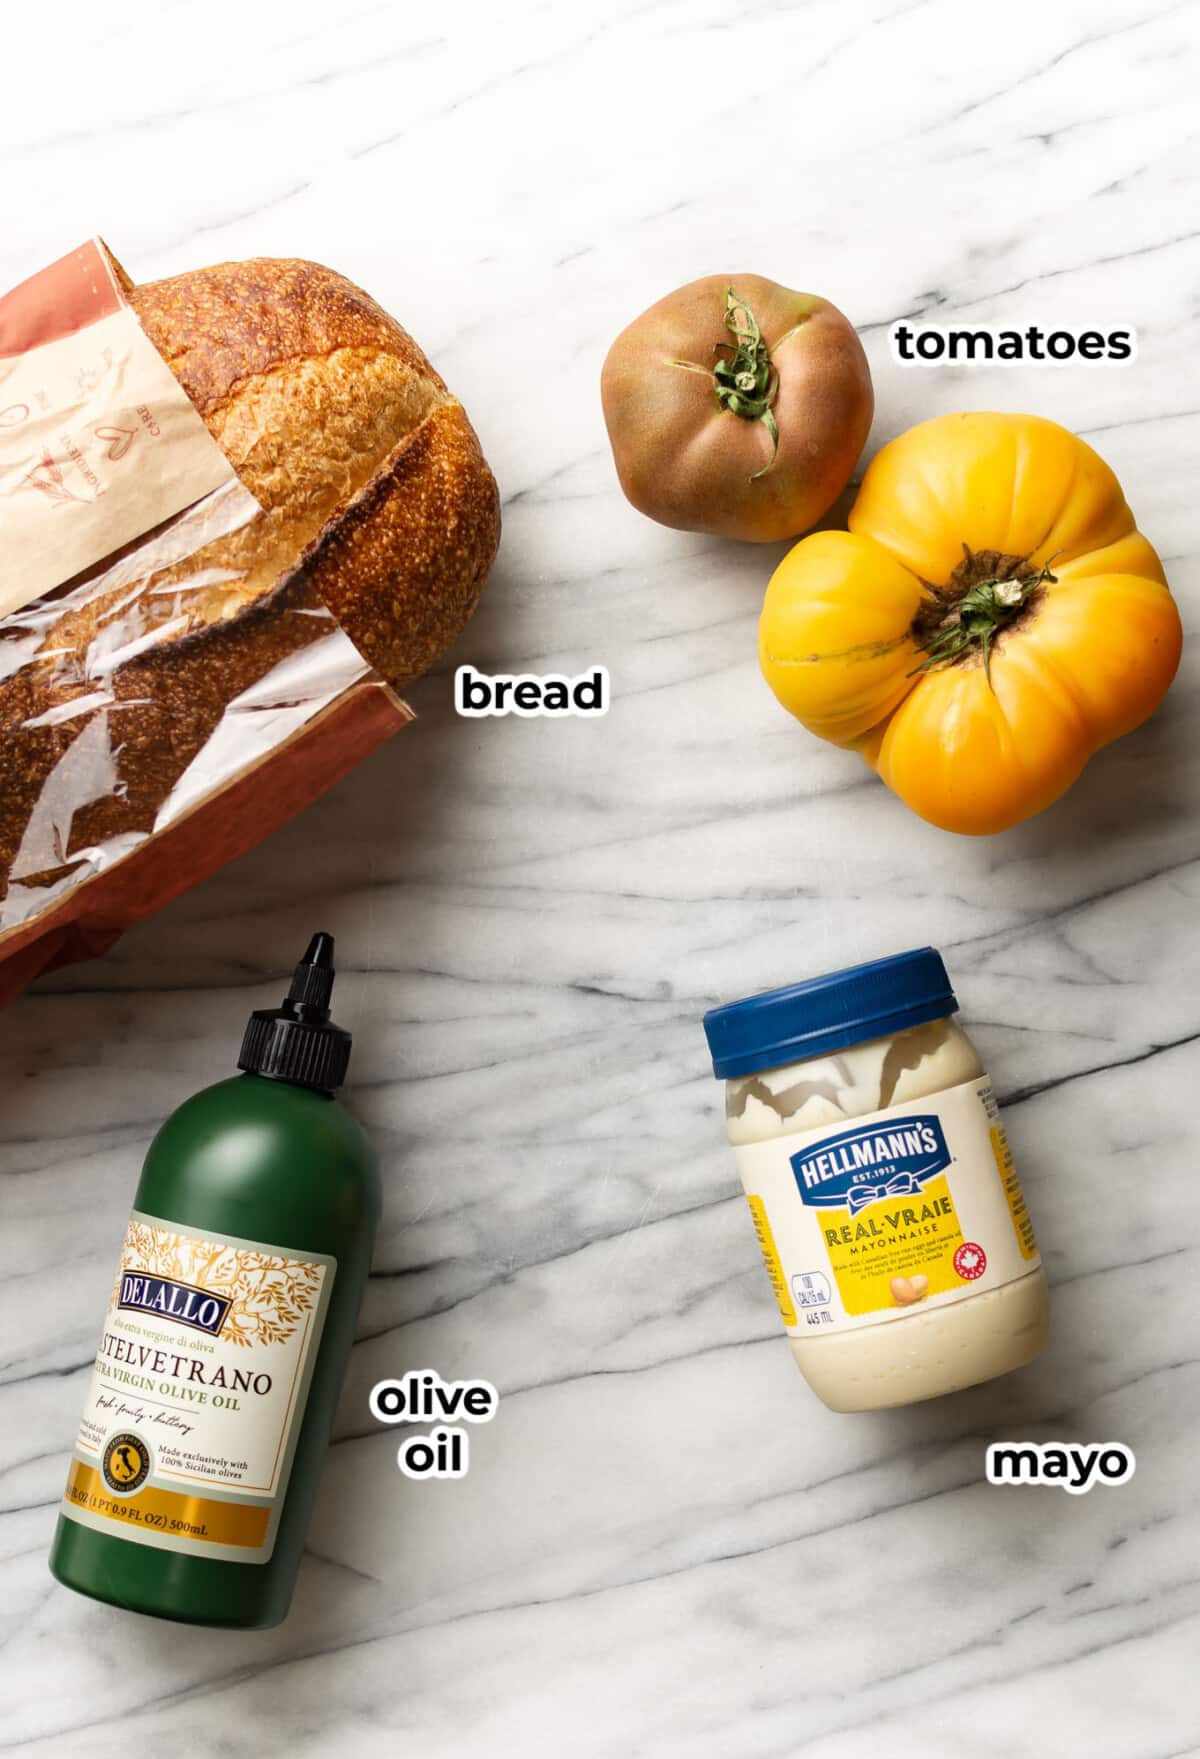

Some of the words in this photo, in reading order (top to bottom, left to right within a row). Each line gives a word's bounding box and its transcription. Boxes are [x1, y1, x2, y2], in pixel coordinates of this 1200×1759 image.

[137, 405, 160, 437] CARE
[801, 1122, 938, 1189] HELLMANN'S
[850, 1223, 939, 1256] MAYONNAISE
[122, 1277, 220, 1327] DELALLO
[142, 1328, 175, 1345] vergine
[177, 1335, 187, 1348] di
[189, 1341, 215, 1354] oliva
[101, 1333, 272, 1395] STELVETRANO
[112, 1367, 154, 1391] VIRGIN
[159, 1382, 207, 1404] OLIVE
[212, 1394, 241, 1411] OIL
[153, 1412, 196, 1436] buttery
[158, 1444, 181, 1458] Made
[182, 1450, 228, 1468] exclusively
[230, 1458, 248, 1471] with
[161, 1455, 183, 1469] 100%
[185, 1460, 217, 1476] Sicilian
[218, 1467, 242, 1479] olives
[98, 1495, 112, 1512] PT
[112, 1500, 127, 1516] 0.9
[128, 1508, 143, 1522] FL
[144, 1512, 168, 1529] OZ)
[169, 1518, 208, 1537] 500mL
